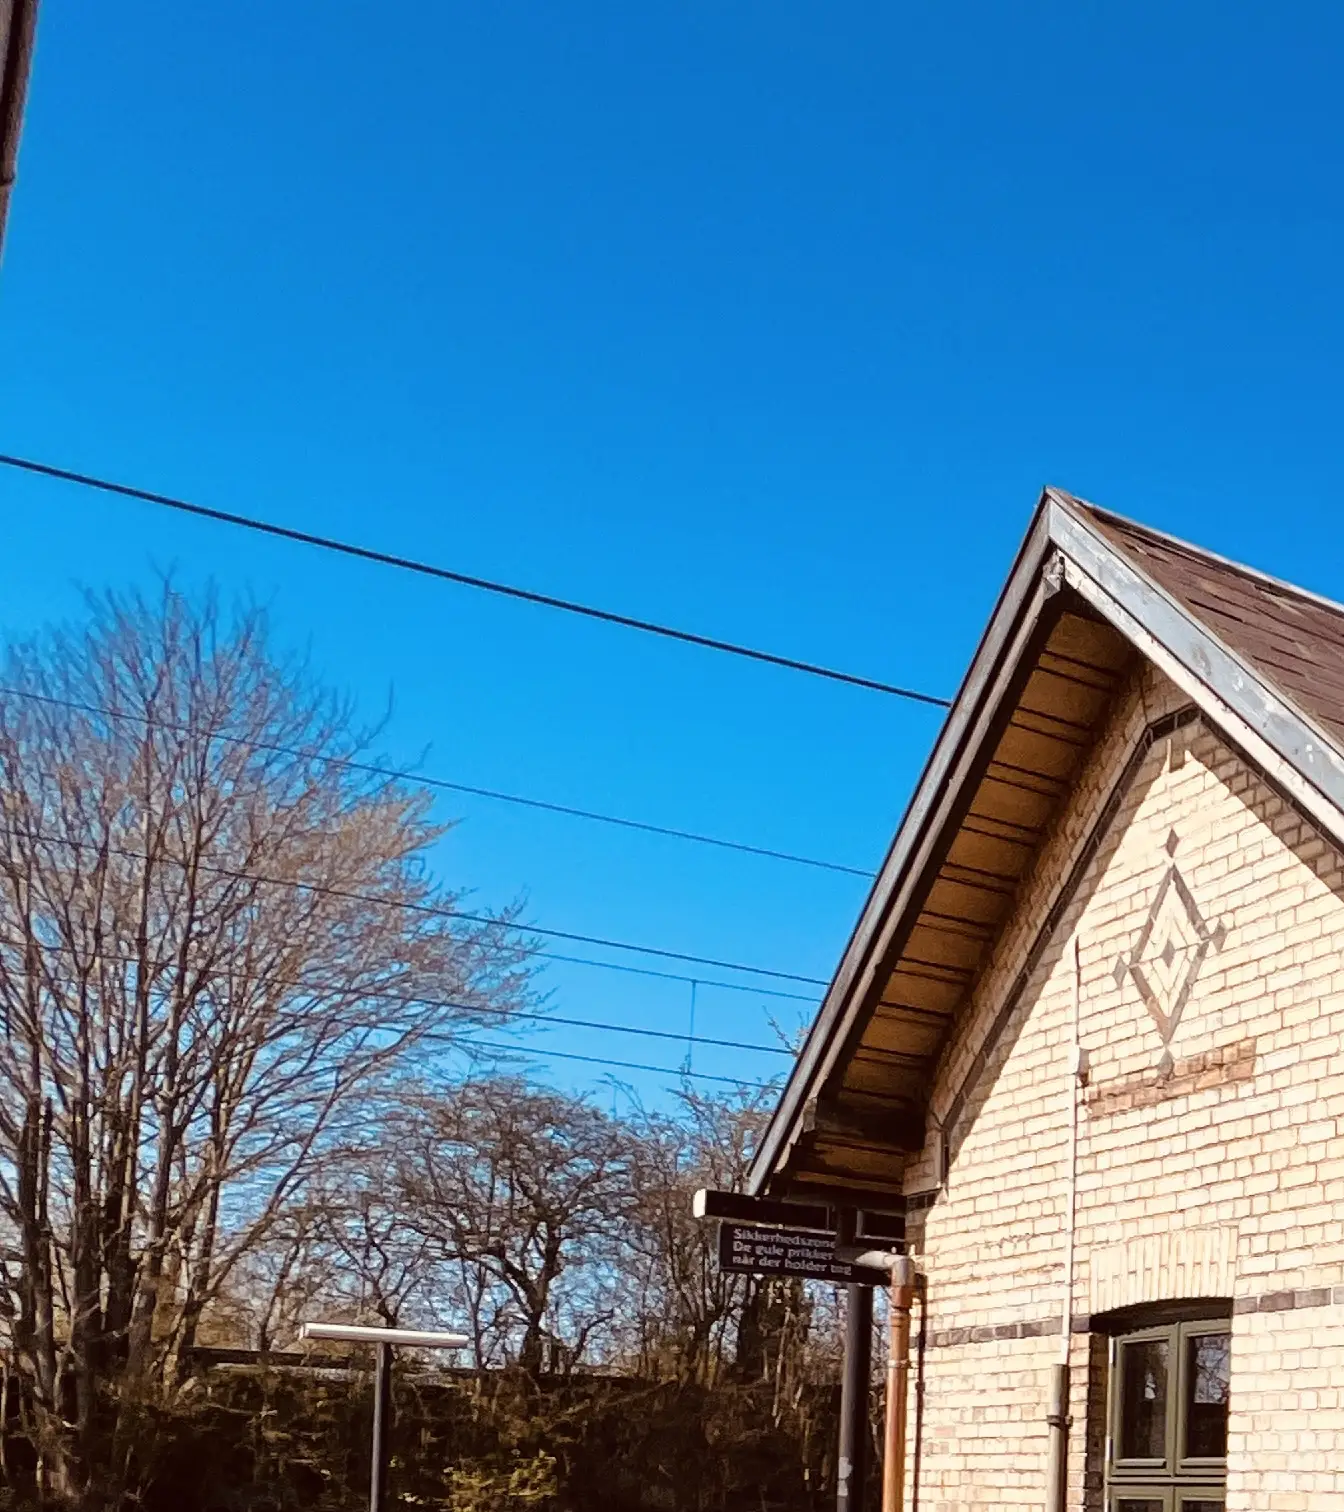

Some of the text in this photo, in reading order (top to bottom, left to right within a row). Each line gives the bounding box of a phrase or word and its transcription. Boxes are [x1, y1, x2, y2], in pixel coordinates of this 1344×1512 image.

[732, 1240, 834, 1261] De gule prikker
[758, 1256, 781, 1267] der
[784, 1258, 828, 1272] holder
